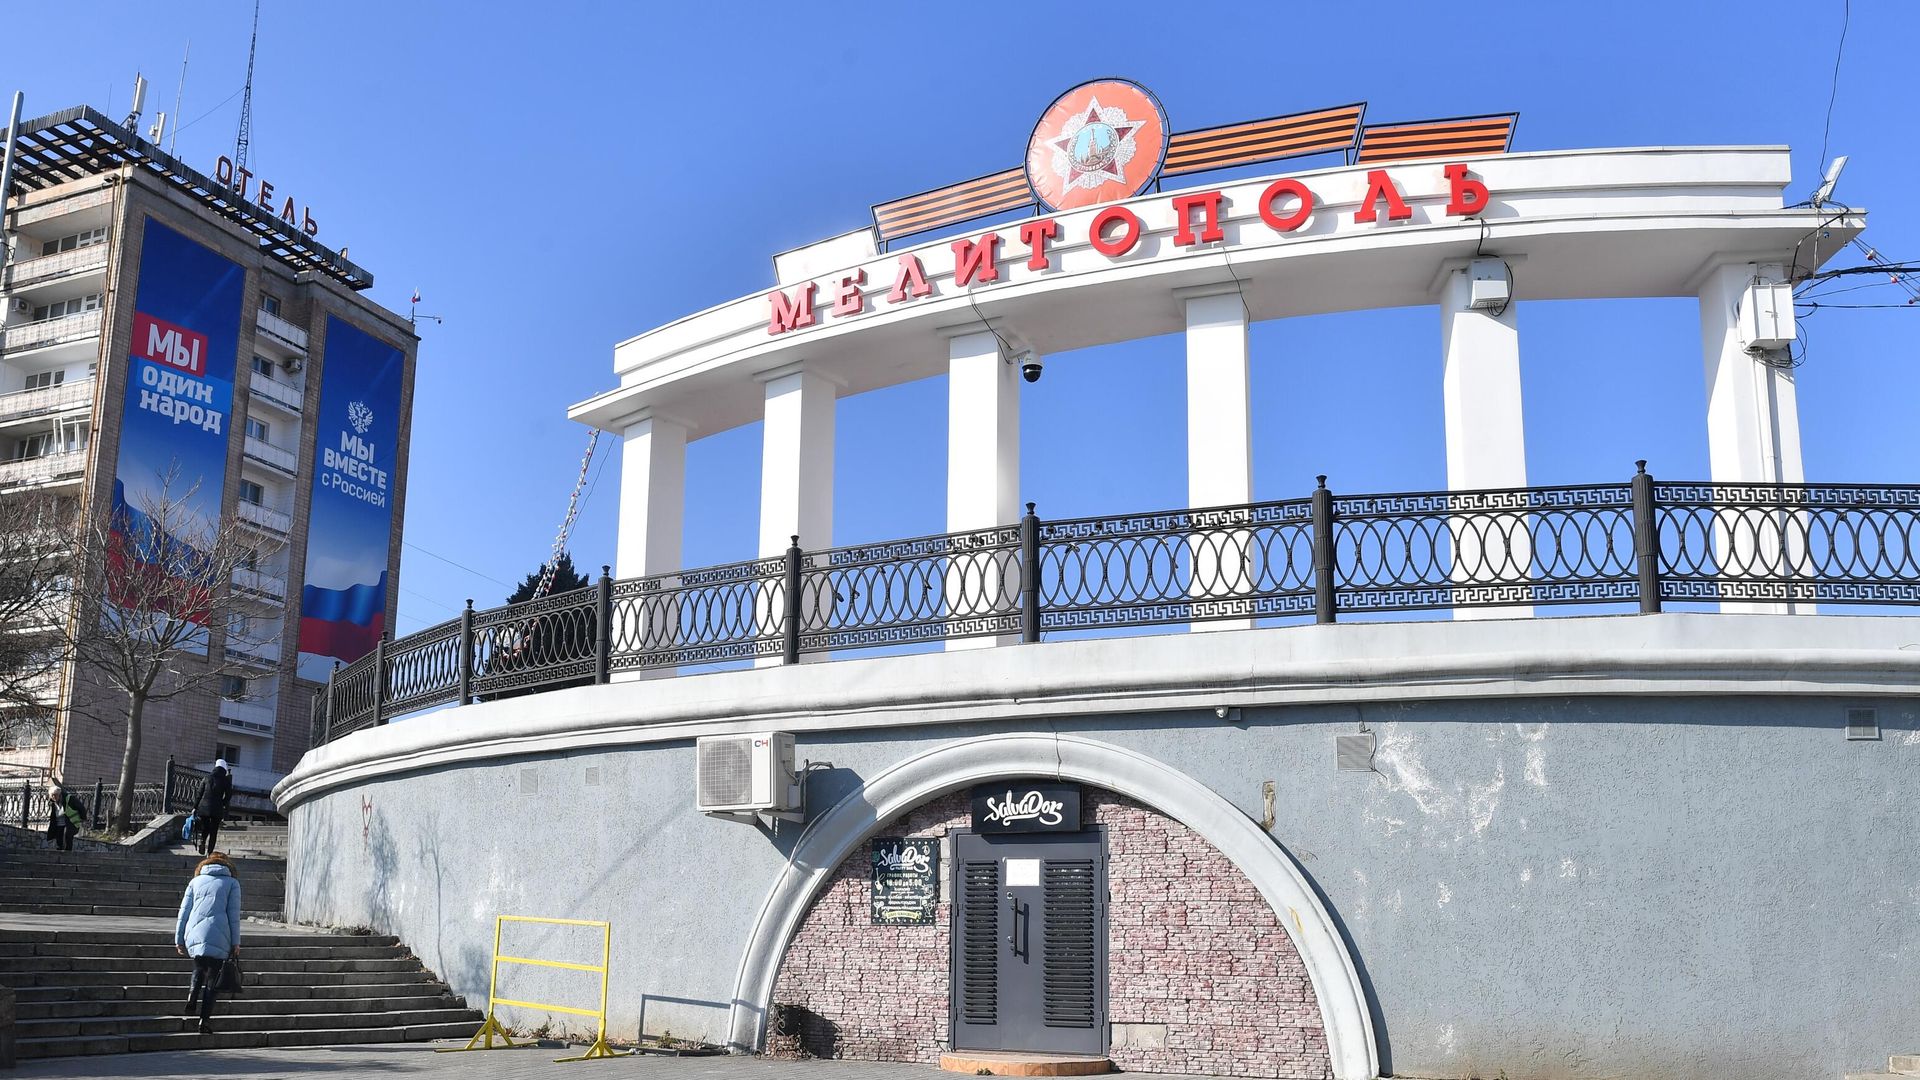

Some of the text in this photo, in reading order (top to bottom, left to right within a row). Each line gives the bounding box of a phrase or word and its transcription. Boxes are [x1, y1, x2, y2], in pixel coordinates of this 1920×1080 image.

[216, 155, 318, 237] ОТЕЛЬ
[768, 163, 1489, 336] МЕЛИТОПОЛЬ
[146, 323, 200, 372] МЫ
[142, 365, 214, 404] один
[139, 389, 222, 435] народ
[323, 447, 388, 490] ВМЕСТЕ
[340, 430, 375, 464] МЫ
[321, 472, 386, 508] с Россией
